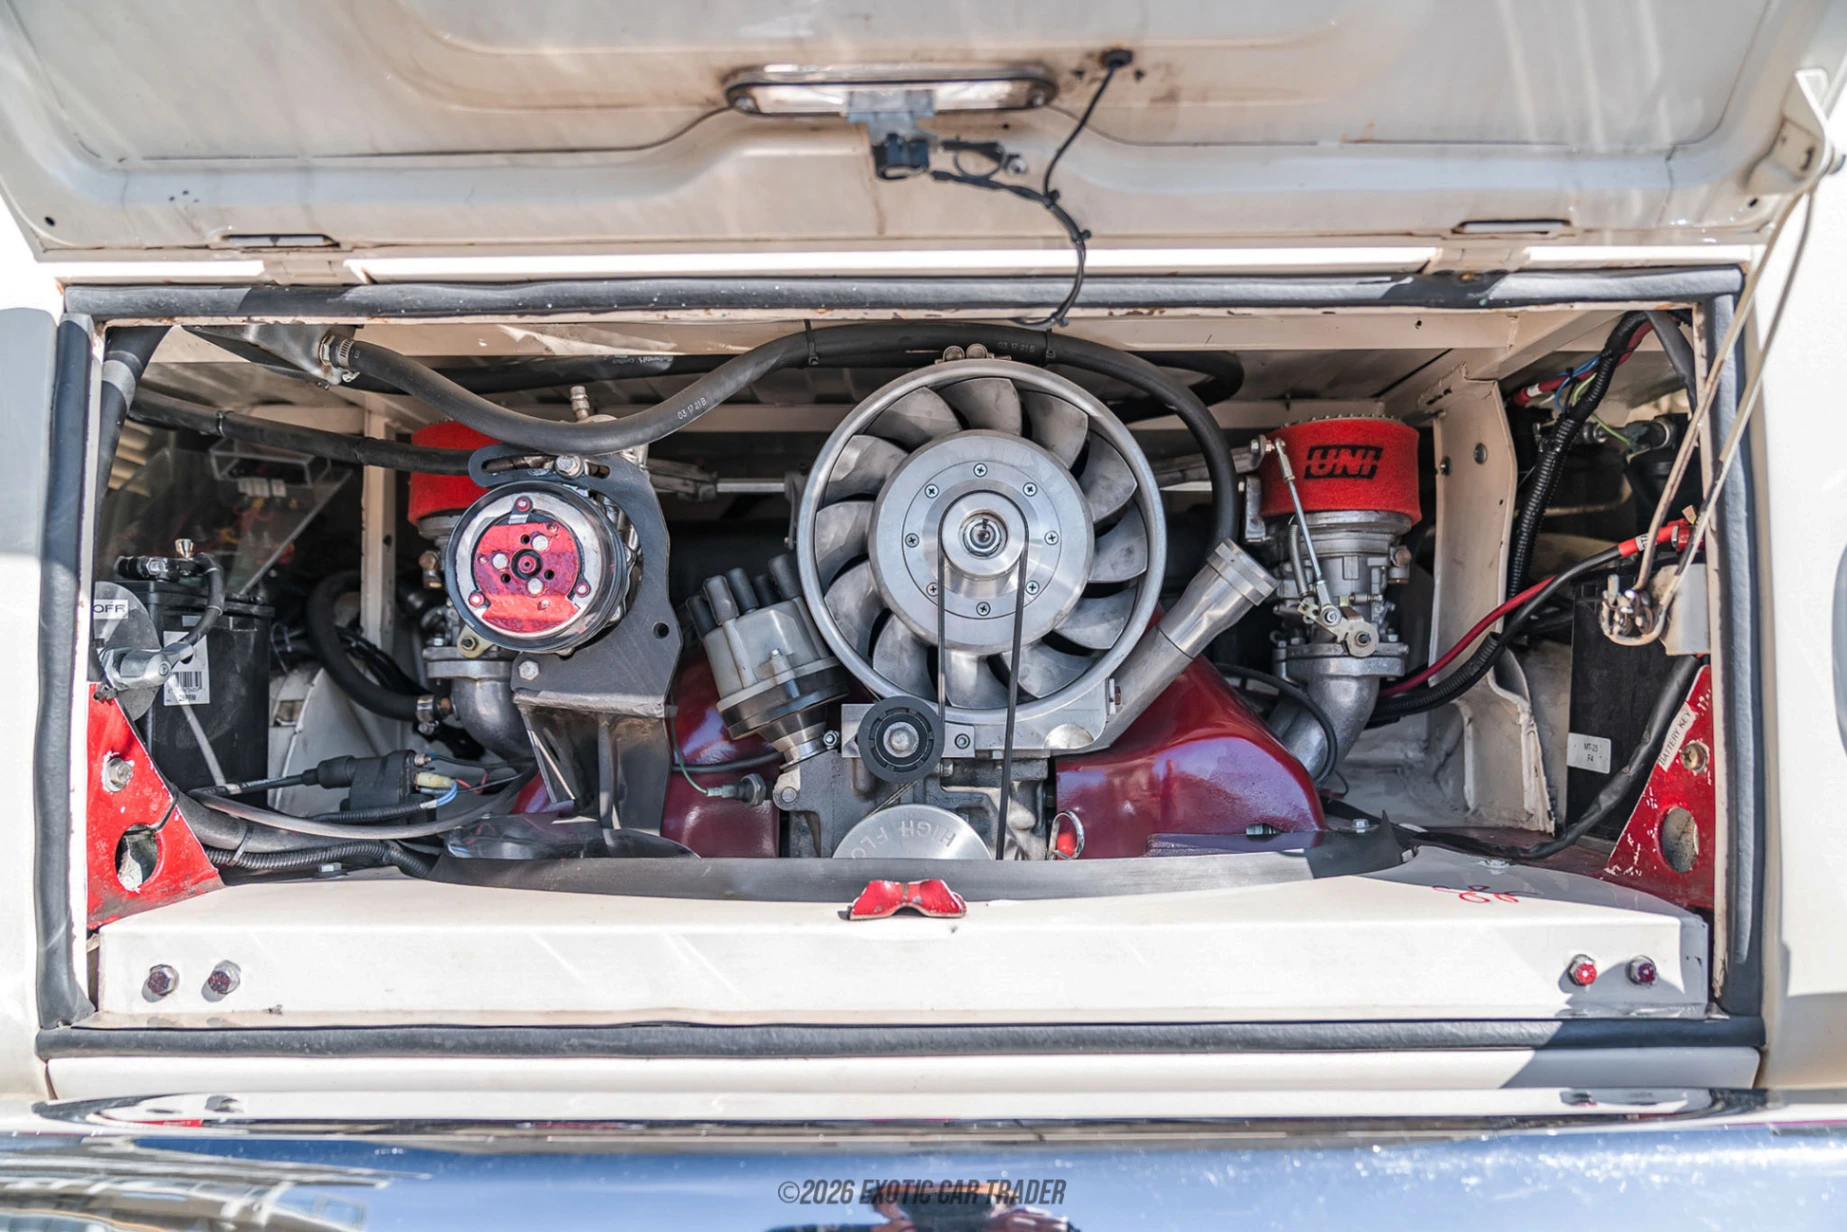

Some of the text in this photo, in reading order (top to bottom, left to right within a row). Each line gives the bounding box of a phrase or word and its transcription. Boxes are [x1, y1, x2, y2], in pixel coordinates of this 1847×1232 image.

[1306, 446, 1380, 478] UNI
[93, 604, 126, 614] OFF
[1660, 710, 1691, 766] BATTERY KEY
[900, 819, 957, 848] HIGH
